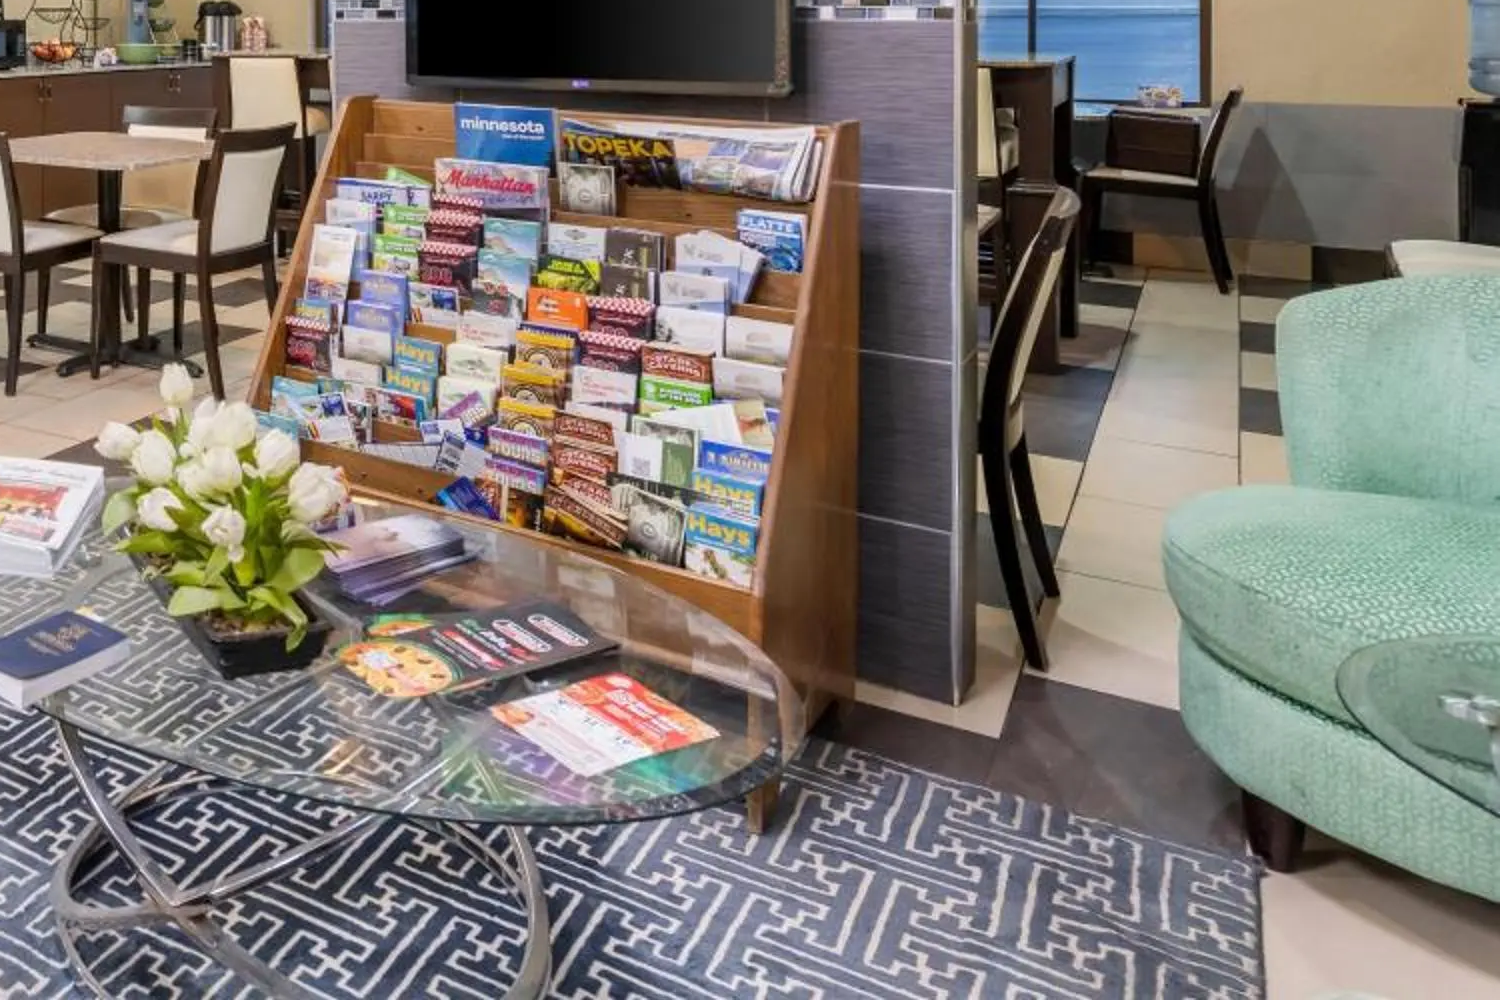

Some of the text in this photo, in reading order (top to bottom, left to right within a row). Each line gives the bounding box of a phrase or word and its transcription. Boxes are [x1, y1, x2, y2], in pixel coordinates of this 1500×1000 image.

[460, 116, 545, 134] minnesota
[562, 132, 674, 159] TOPEKA
[448, 167, 536, 194] Manhattan
[694, 474, 756, 502] Hays
[687, 511, 751, 547] Hays
